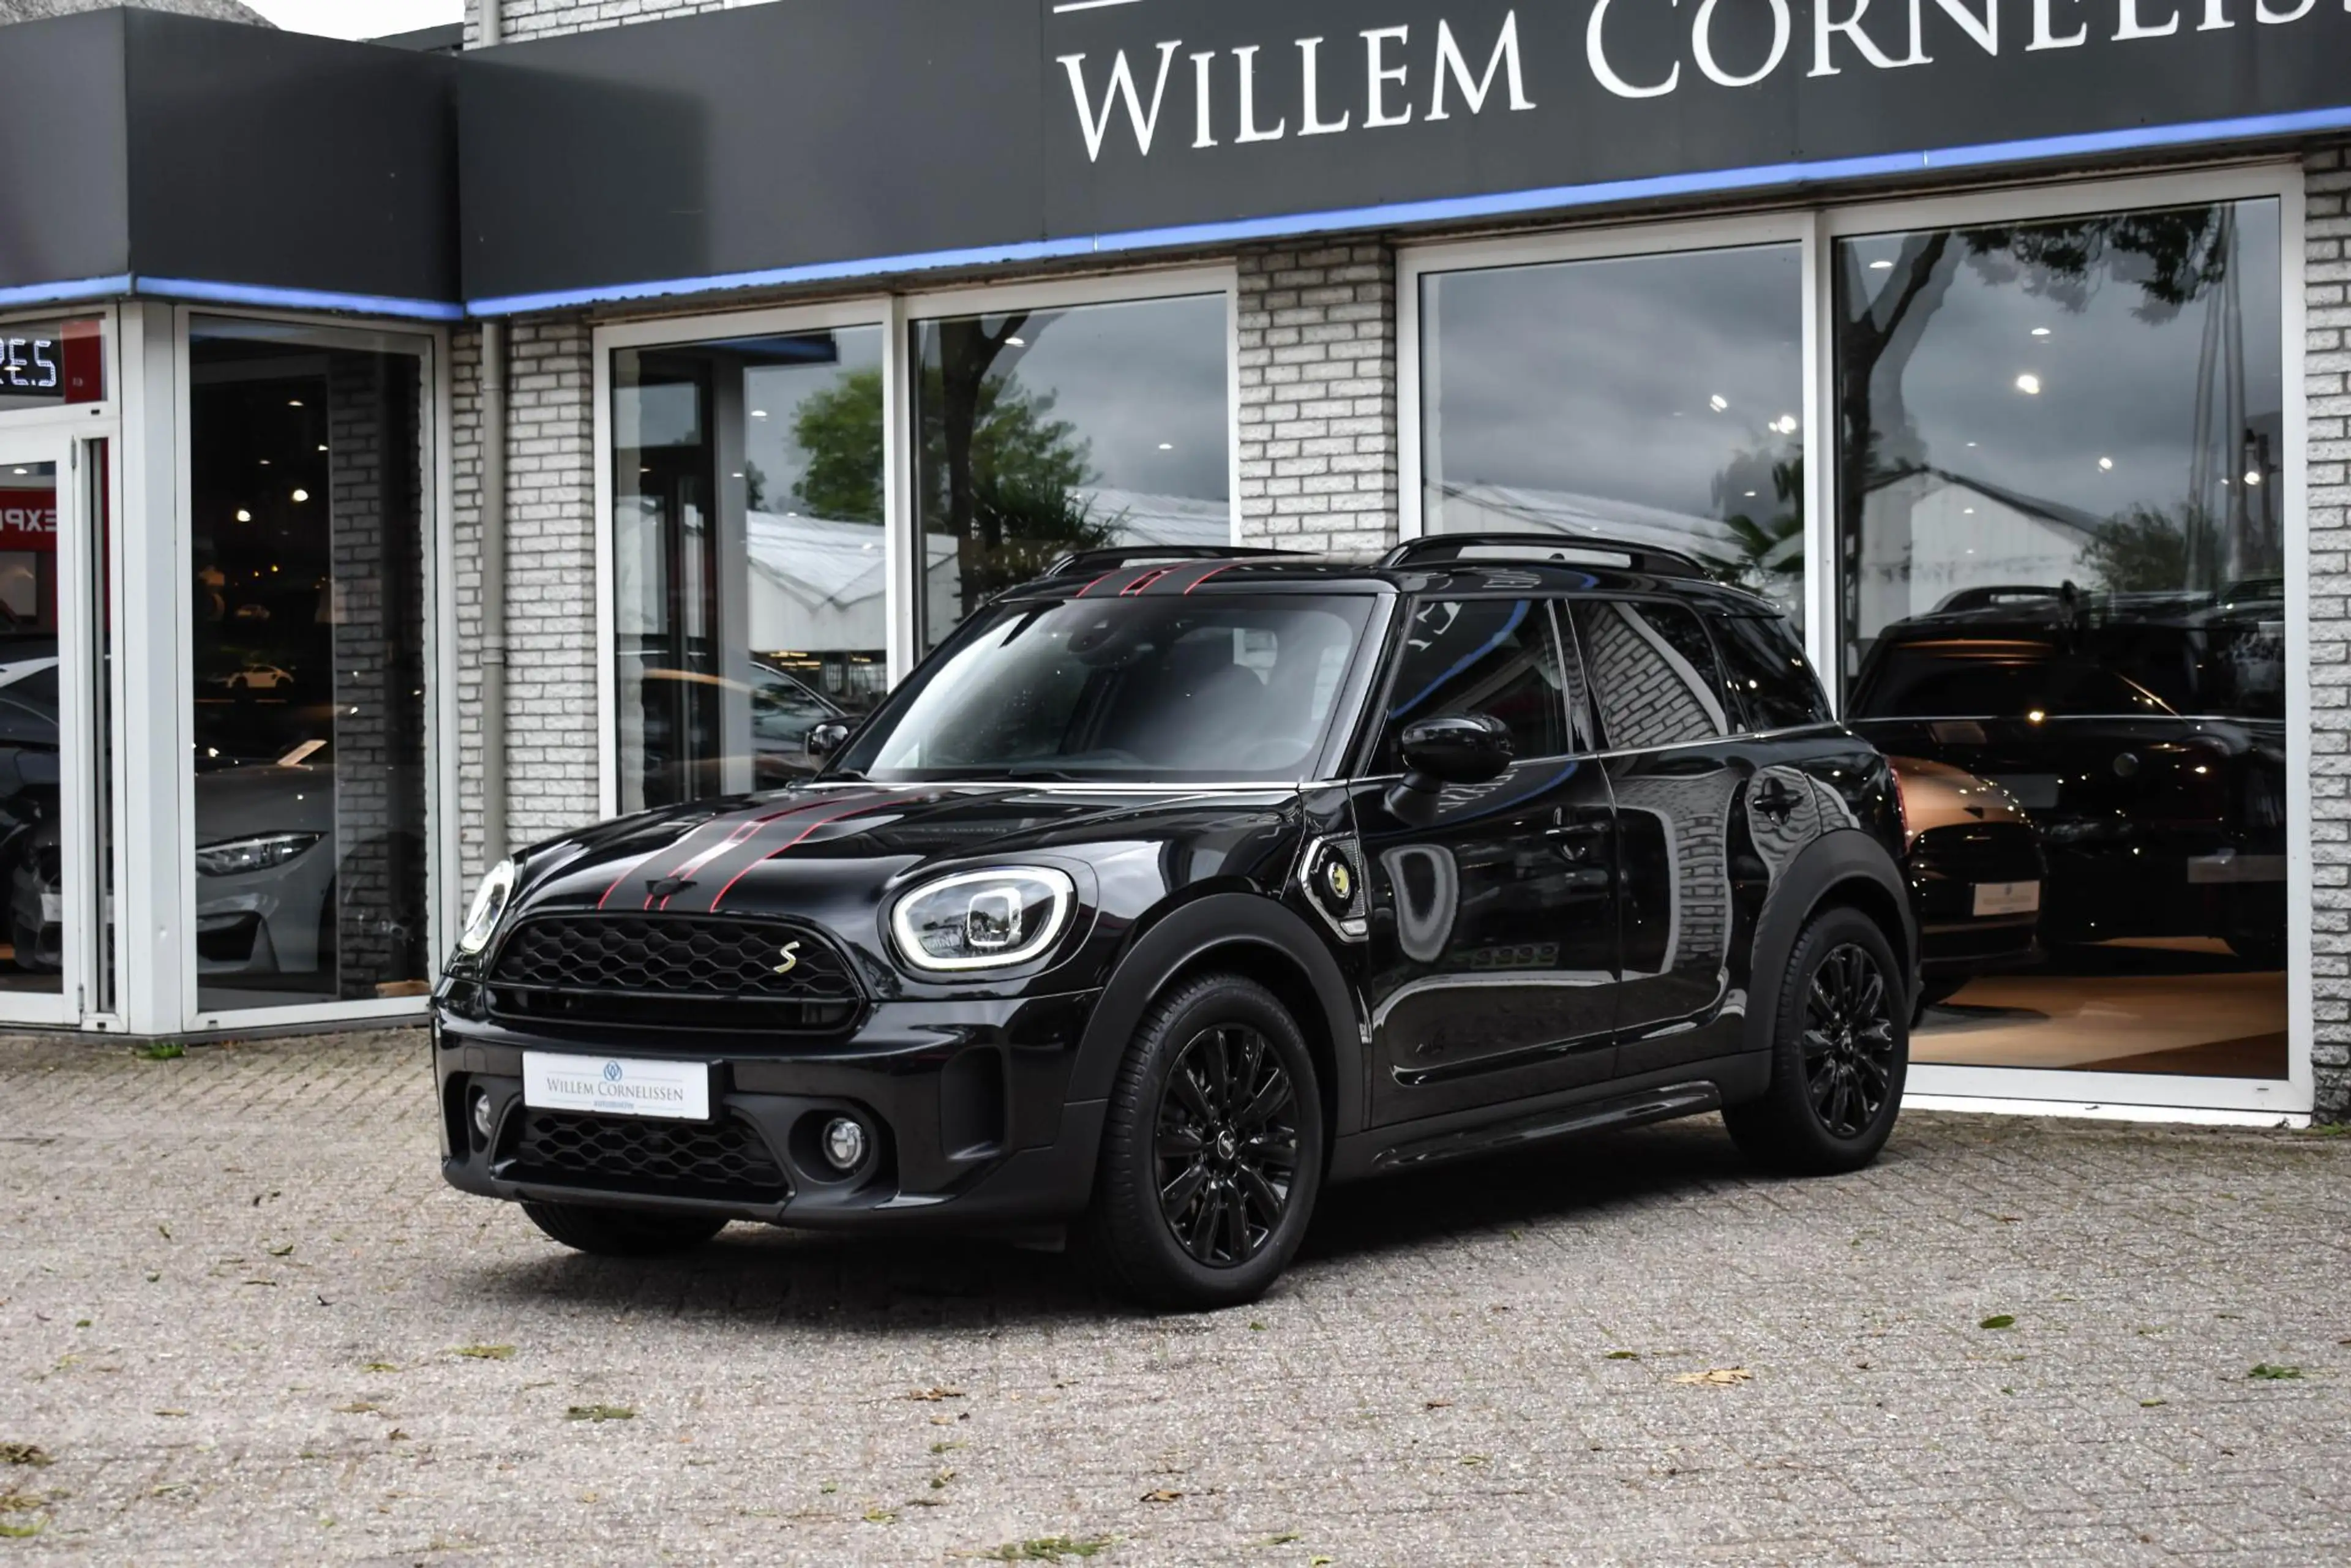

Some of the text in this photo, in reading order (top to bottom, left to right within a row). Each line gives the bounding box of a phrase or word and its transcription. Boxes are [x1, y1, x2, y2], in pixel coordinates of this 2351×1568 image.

[1056, 10, 1537, 162] WILLEM
[773, 941, 800, 973] S
[546, 1077, 683, 1101] WILLEM CORNELISSEN
